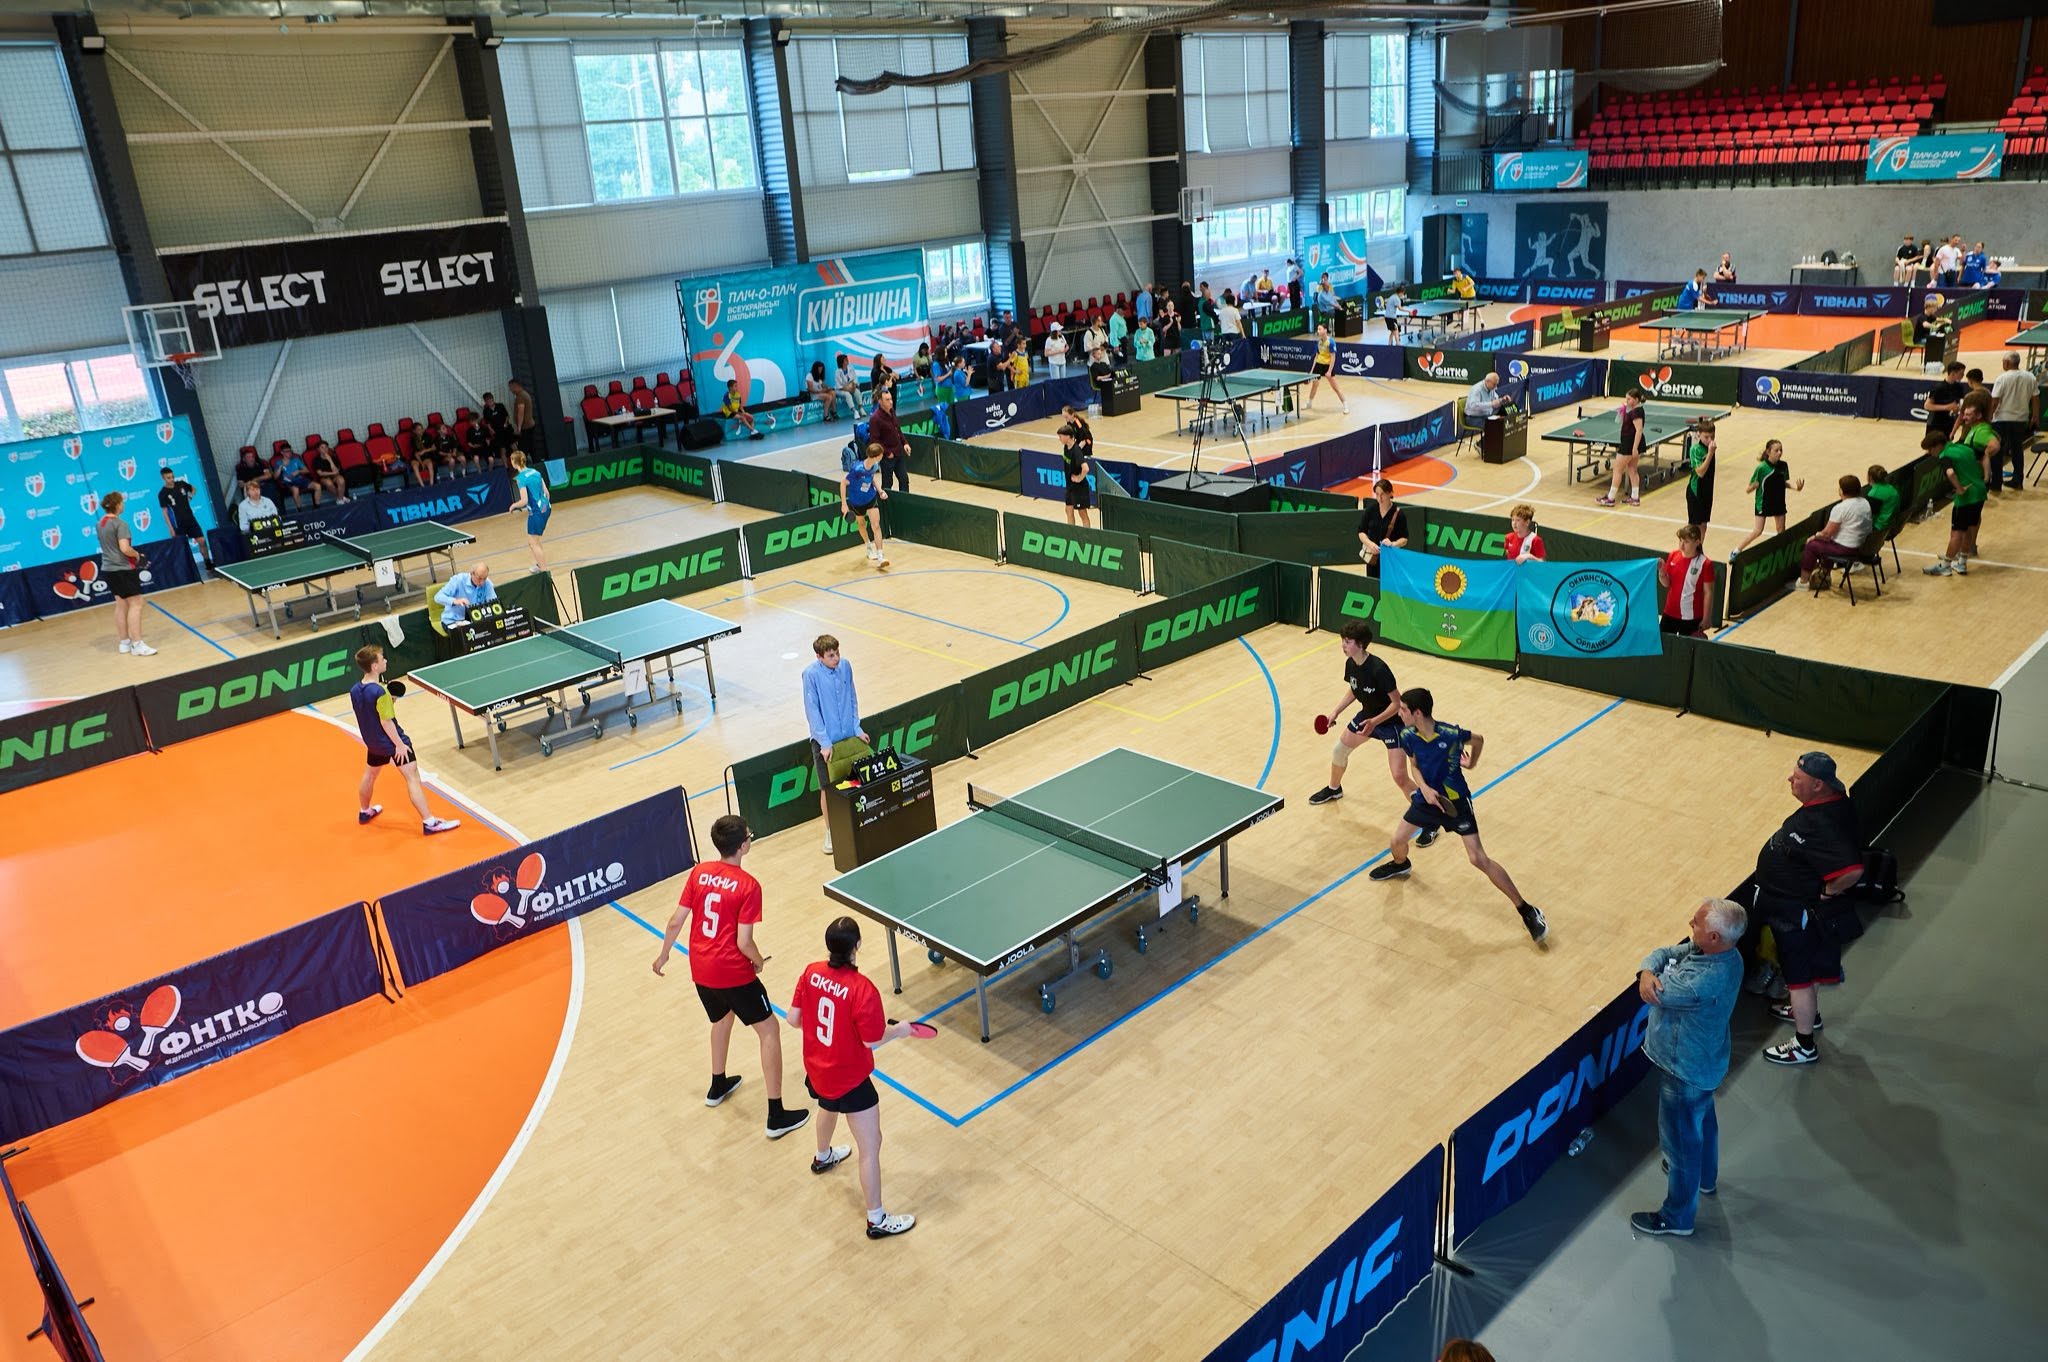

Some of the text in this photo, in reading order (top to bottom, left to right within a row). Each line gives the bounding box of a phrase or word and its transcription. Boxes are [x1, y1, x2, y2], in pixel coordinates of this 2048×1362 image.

[380, 251, 495, 296] SELECT
[193, 270, 326, 318] SELECT
[728, 283, 798, 303] ПЛІЧ-О-ПЛІЧ
[1476, 285, 1520, 297] ONIC
[1537, 285, 1595, 299] DONIC
[1652, 295, 1679, 311] DON
[1717, 292, 1766, 305] TIBHAR
[1814, 296, 1867, 308] TIBHAR
[806, 287, 912, 333] КИЇВЩИНА
[1263, 316, 1304, 335] DONIC
[1482, 329, 1527, 351] DONIC
[1537, 379, 1572, 401] TIBHAR
[1782, 384, 1848, 395] UKRAINIAN TABLE
[1782, 391, 1857, 403] TENNIS FEDERATION
[993, 409, 1004, 418] cup
[653, 458, 703, 487] DONIC
[1036, 467, 1096, 492] TIBR
[387, 495, 463, 524] TIBHAR
[765, 512, 868, 556] DONI
[1021, 530, 1124, 571] DONIC
[601, 547, 723, 601] DONIC
[1568, 574, 1613, 589] ОКНЯНСЬКІ
[471, 609, 482, 621] 0
[492, 603, 502, 615] 0
[1142, 586, 1259, 652] DONIC
[1575, 637, 1608, 650] ОРЛАНИ
[177, 649, 348, 721] DONIC
[988, 639, 1117, 720] DONIC
[493, 698, 517, 710] JOOLA
[0, 713, 108, 770] NIC
[768, 714, 937, 809] DIC
[860, 755, 897, 782] 7 2 2 4
[698, 873, 737, 892] ОКНИ
[702, 892, 722, 939] 5
[902, 928, 928, 947] JOOLA
[1006, 943, 1035, 966] JOOLA
[810, 972, 848, 1001] ОКНИ
[816, 996, 835, 1047] 9
[1247, 1215, 1403, 1362] NIC
